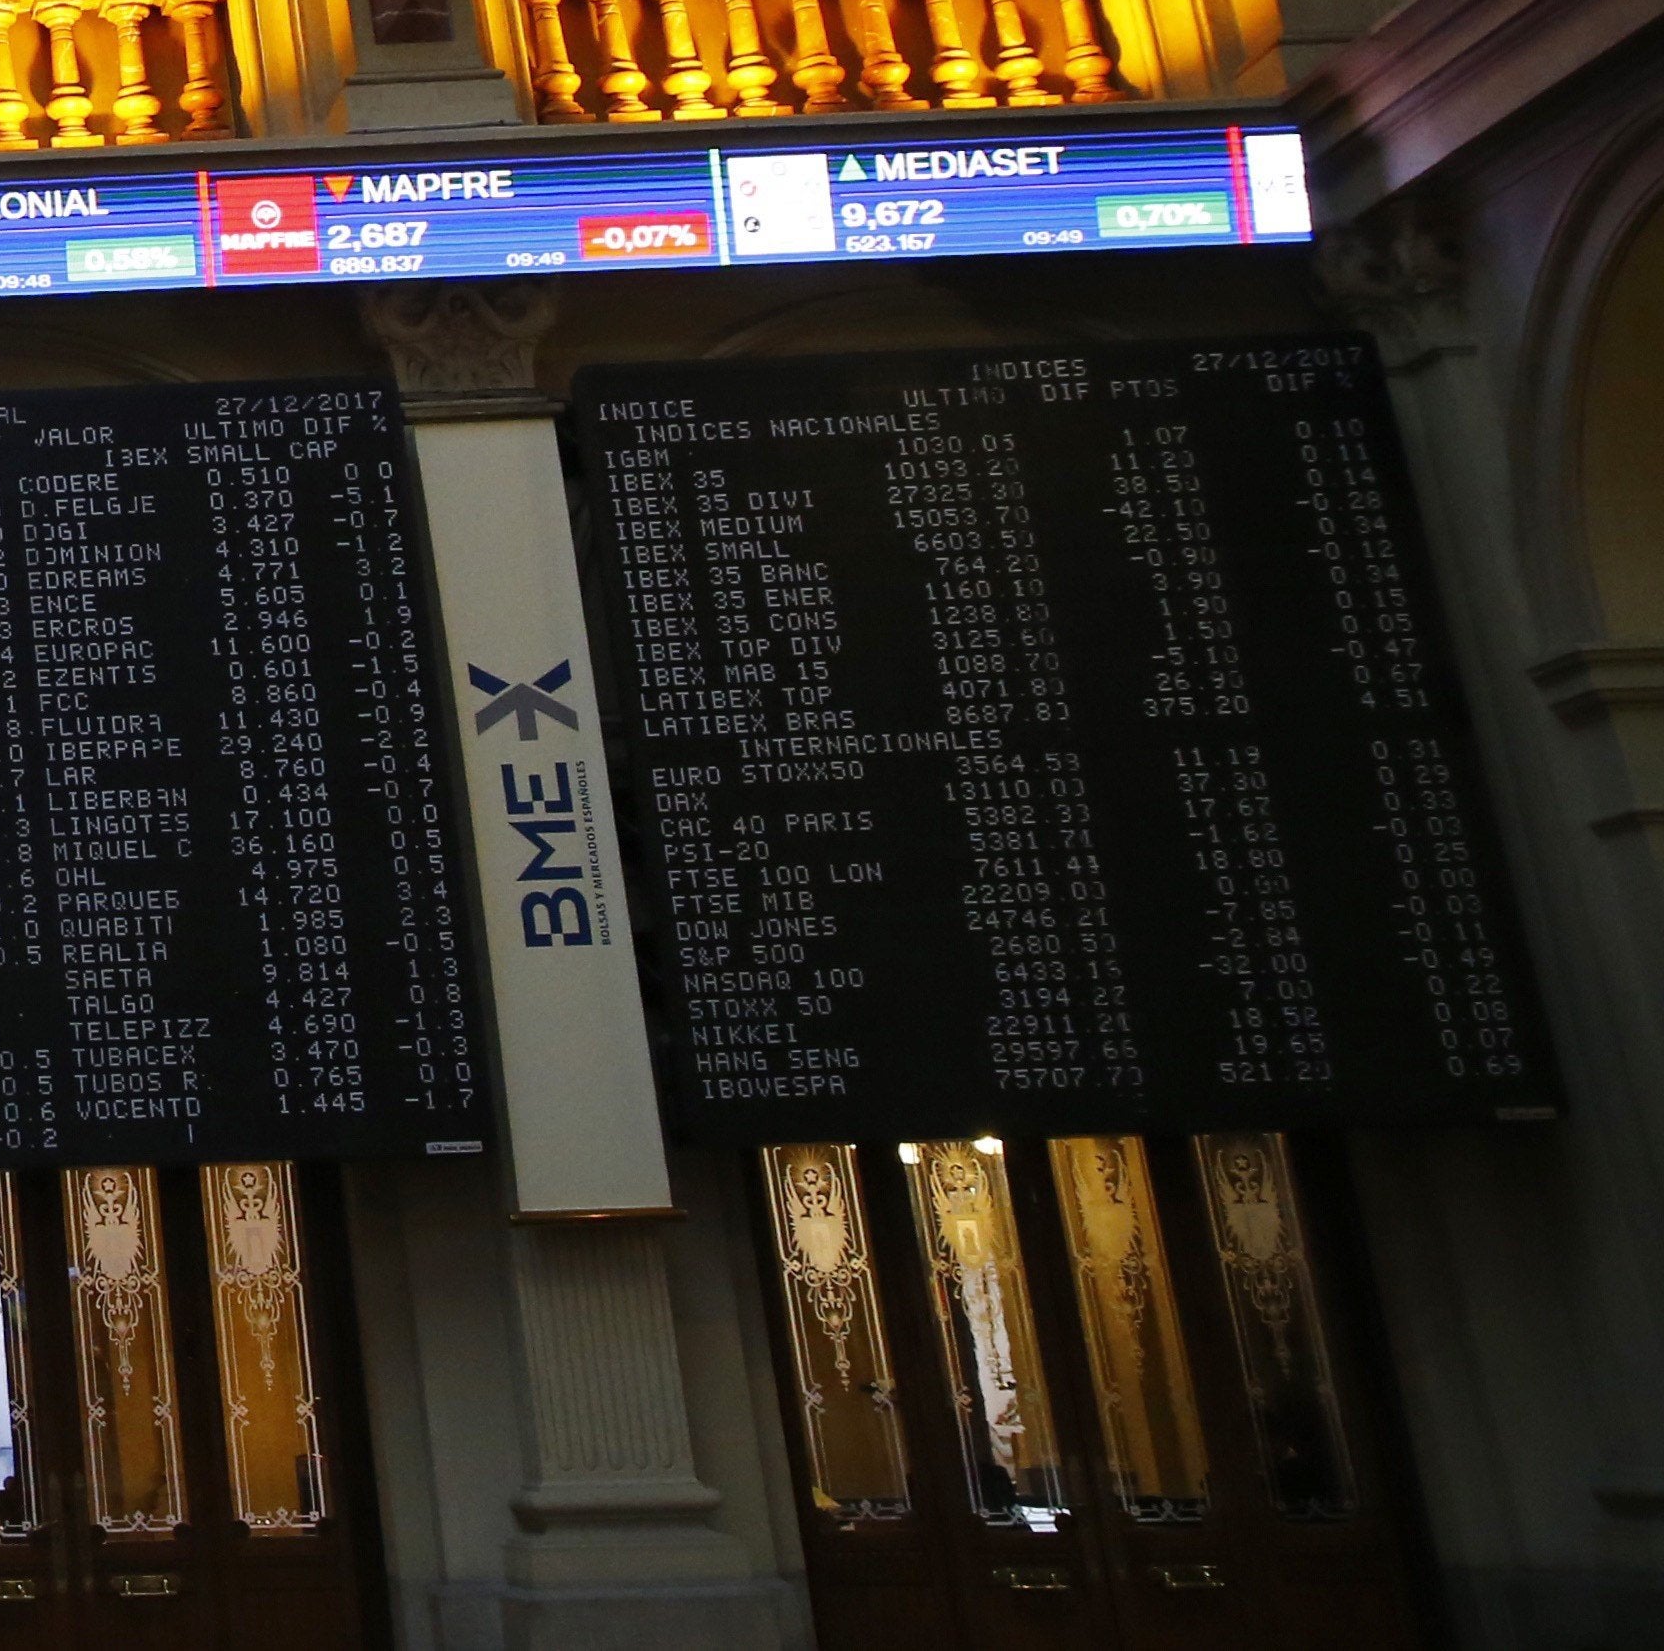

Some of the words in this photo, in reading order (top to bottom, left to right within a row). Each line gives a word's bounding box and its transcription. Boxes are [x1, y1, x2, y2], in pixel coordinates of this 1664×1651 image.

[876, 147, 1065, 181] MEDIASET
[362, 170, 515, 204] MAPFRE
[842, 200, 945, 231] 9,672
[220, 231, 317, 251] MAPFRE
[328, 222, 428, 252] 2,687
[591, 226, 698, 250] -0,07%
[1023, 229, 1084, 246] 09:49
[636, 420, 753, 444] INDICES
[770, 412, 941, 438] NACIONALES
[28, 567, 147, 590] EDREAMS
[218, 562, 299, 583] 4.771
[33, 617, 134, 640] ERCROS
[224, 613, 308, 632] 2.946
[740, 730, 1003, 759] INTERNACIONALES
[661, 816, 712, 838] CAC
[733, 815, 766, 836] 40
[786, 810, 873, 833] PARIS
[500, 762, 592, 948] BME
[677, 921, 728, 941] DOW
[751, 916, 838, 938] JONES
[684, 970, 792, 994] NASDAQ
[69, 993, 155, 1015] TALGO
[266, 987, 352, 1009] 4.427
[70, 1018, 212, 1043] TELEPIZZ
[73, 1044, 197, 1068] TUBACEX
[703, 1075, 848, 1100] IBOVESPA
